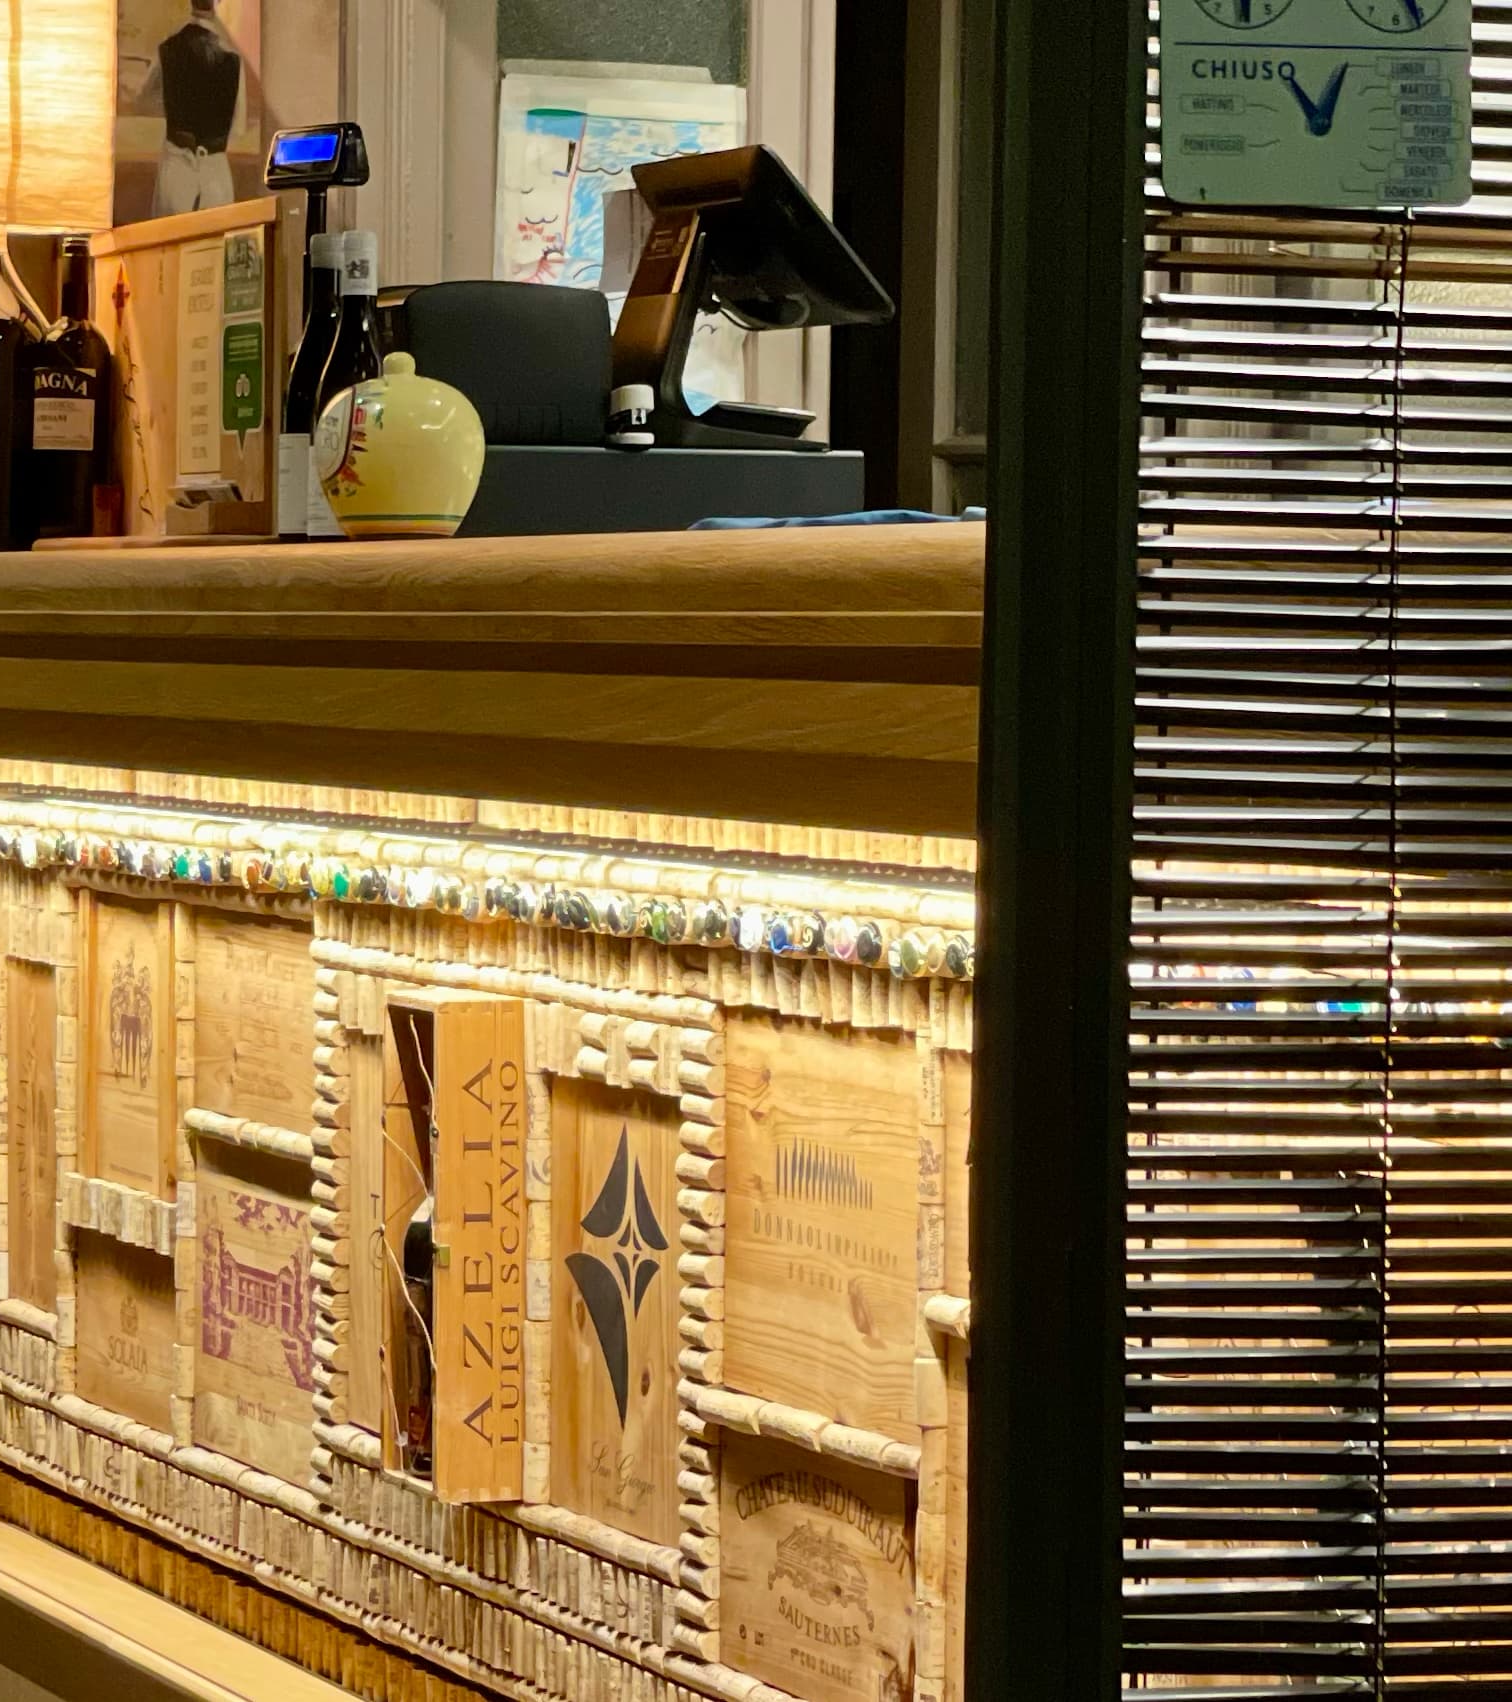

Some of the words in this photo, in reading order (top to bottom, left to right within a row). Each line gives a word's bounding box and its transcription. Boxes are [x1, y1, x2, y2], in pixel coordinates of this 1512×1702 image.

[1392, 15, 1400, 26] 6
[1192, 59, 1295, 80] CHIUSO
[499, 1060, 521, 1285] SCAVINO
[462, 1058, 494, 1449] AZELIA
[499, 1303, 521, 1445] LUIGI
[778, 1596, 862, 1648] SAUTERNES
